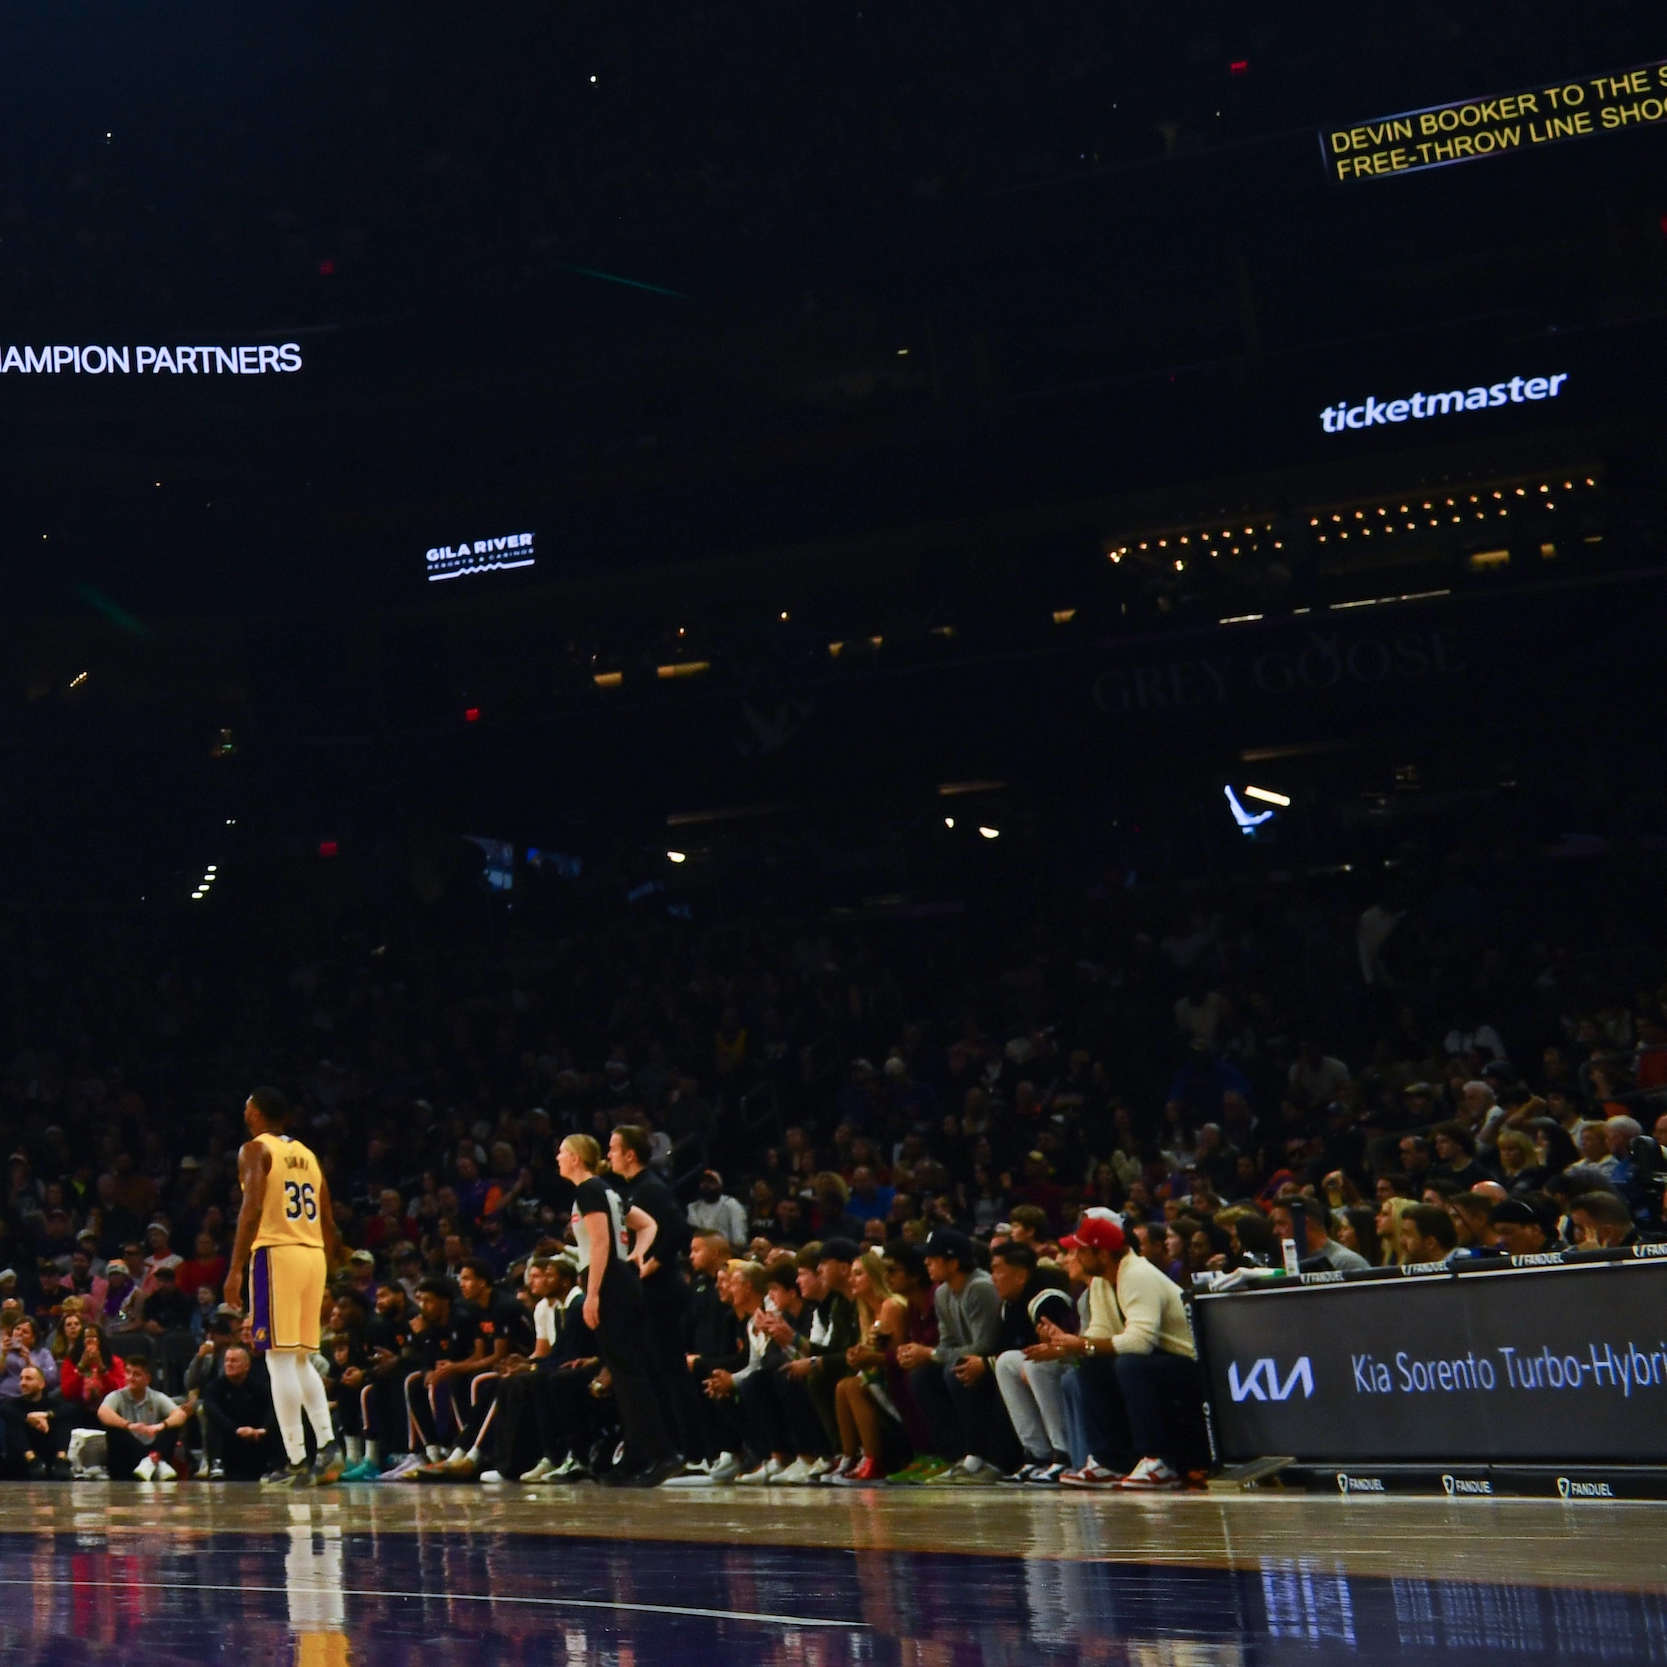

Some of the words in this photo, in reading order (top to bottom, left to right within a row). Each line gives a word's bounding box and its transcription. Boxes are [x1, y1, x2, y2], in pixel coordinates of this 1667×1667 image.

[1329, 117, 1415, 154] DEVIN
[1419, 93, 1538, 135] BOOKER
[1543, 84, 1585, 109] TO
[1590, 70, 1652, 100] THE
[1336, 125, 1521, 181] FREE-THROW
[1529, 111, 1594, 144] LINE
[1601, 97, 1667, 129] SHO
[136, 343, 302, 374] PARTNERS
[1320, 373, 1568, 432] ticketmaster
[426, 544, 471, 562] GILA
[1090, 656, 1231, 716] GREY
[284, 1181, 317, 1221] 36
[1351, 1353, 1392, 1394] Kia
[1396, 1351, 1496, 1394] Sorento
[1348, 1477, 1384, 1492] FANDUEL
[1455, 1478, 1493, 1494] FANDUE
[1571, 1481, 1615, 1497] FANDUEL
